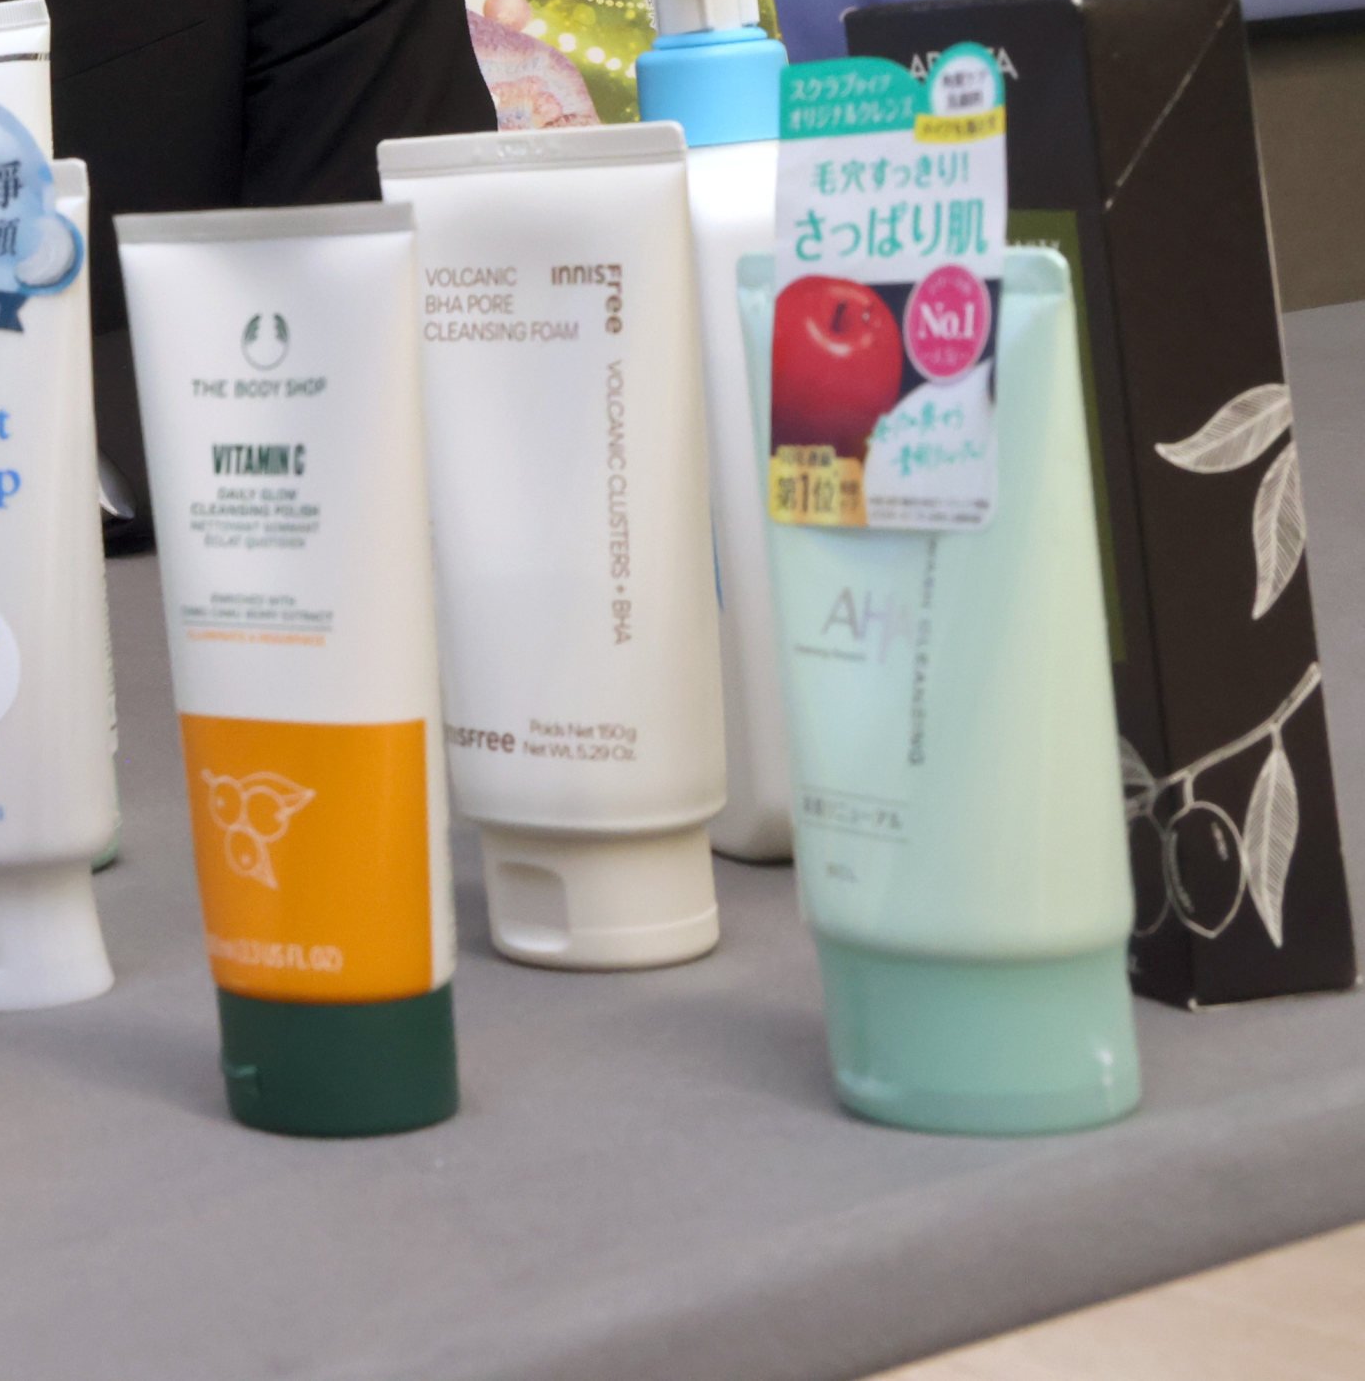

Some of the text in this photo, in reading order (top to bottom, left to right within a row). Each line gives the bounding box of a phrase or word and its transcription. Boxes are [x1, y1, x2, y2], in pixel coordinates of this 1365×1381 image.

[795, 196, 989, 264] さっぱり肌
[425, 266, 518, 288] VOLCANIC
[425, 294, 514, 315] BHA PORE
[424, 320, 579, 343] CLEANSING FOAM
[192, 377, 327, 398] THE BODY SHOP
[212, 443, 306, 475] VITAMIN C
[606, 359, 632, 645] VOLCANIC CLUSTERS BHA
